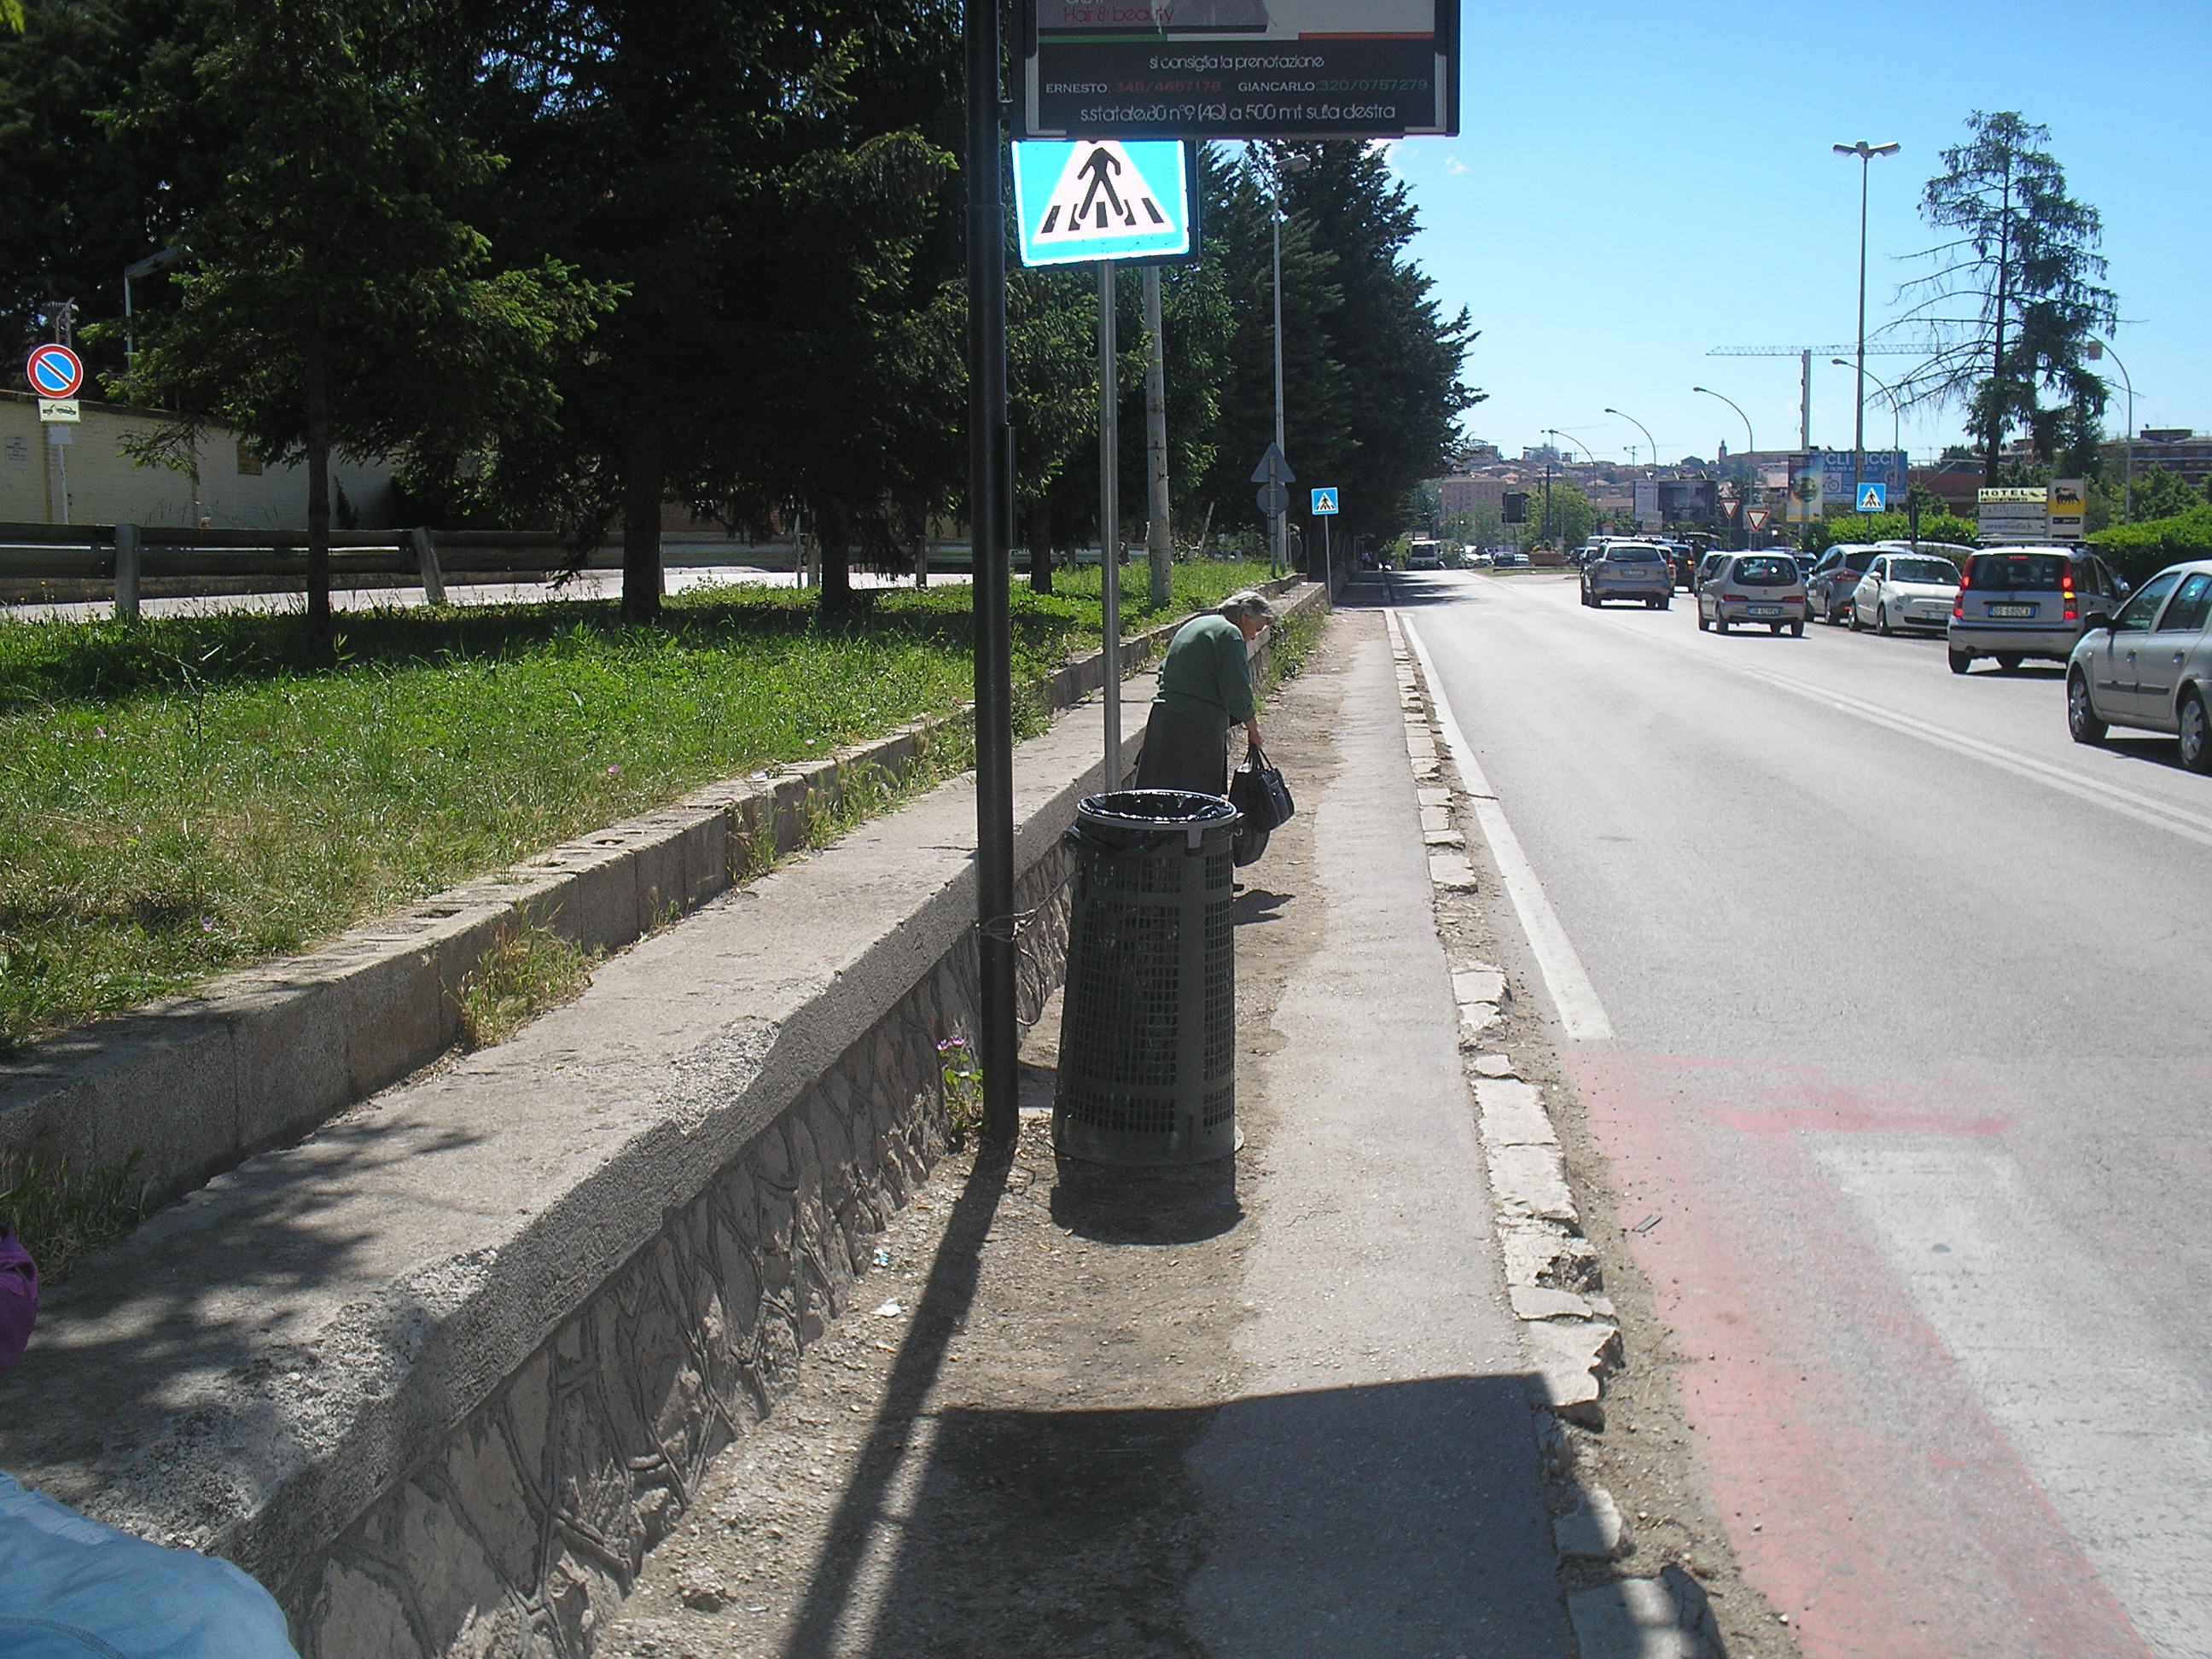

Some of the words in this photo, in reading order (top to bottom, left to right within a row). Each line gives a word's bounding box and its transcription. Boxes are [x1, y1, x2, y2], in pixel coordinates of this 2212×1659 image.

[1063, 7, 1093, 22] Hair
[1150, 55, 1158, 69] si
[1161, 55, 1218, 72] consiglia
[1220, 55, 1232, 69] la
[1235, 55, 1324, 71] prenotazione
[1046, 84, 1108, 93] ERNESTO
[1238, 82, 1315, 91] GIANCARLO
[1230, 108, 1242, 120] a
[1245, 104, 1277, 120] 500
[1280, 104, 1302, 120] mt
[1343, 103, 1396, 119] destra
[1825, 452, 1850, 465] CLI
[1854, 452, 1895, 465] ICCI
